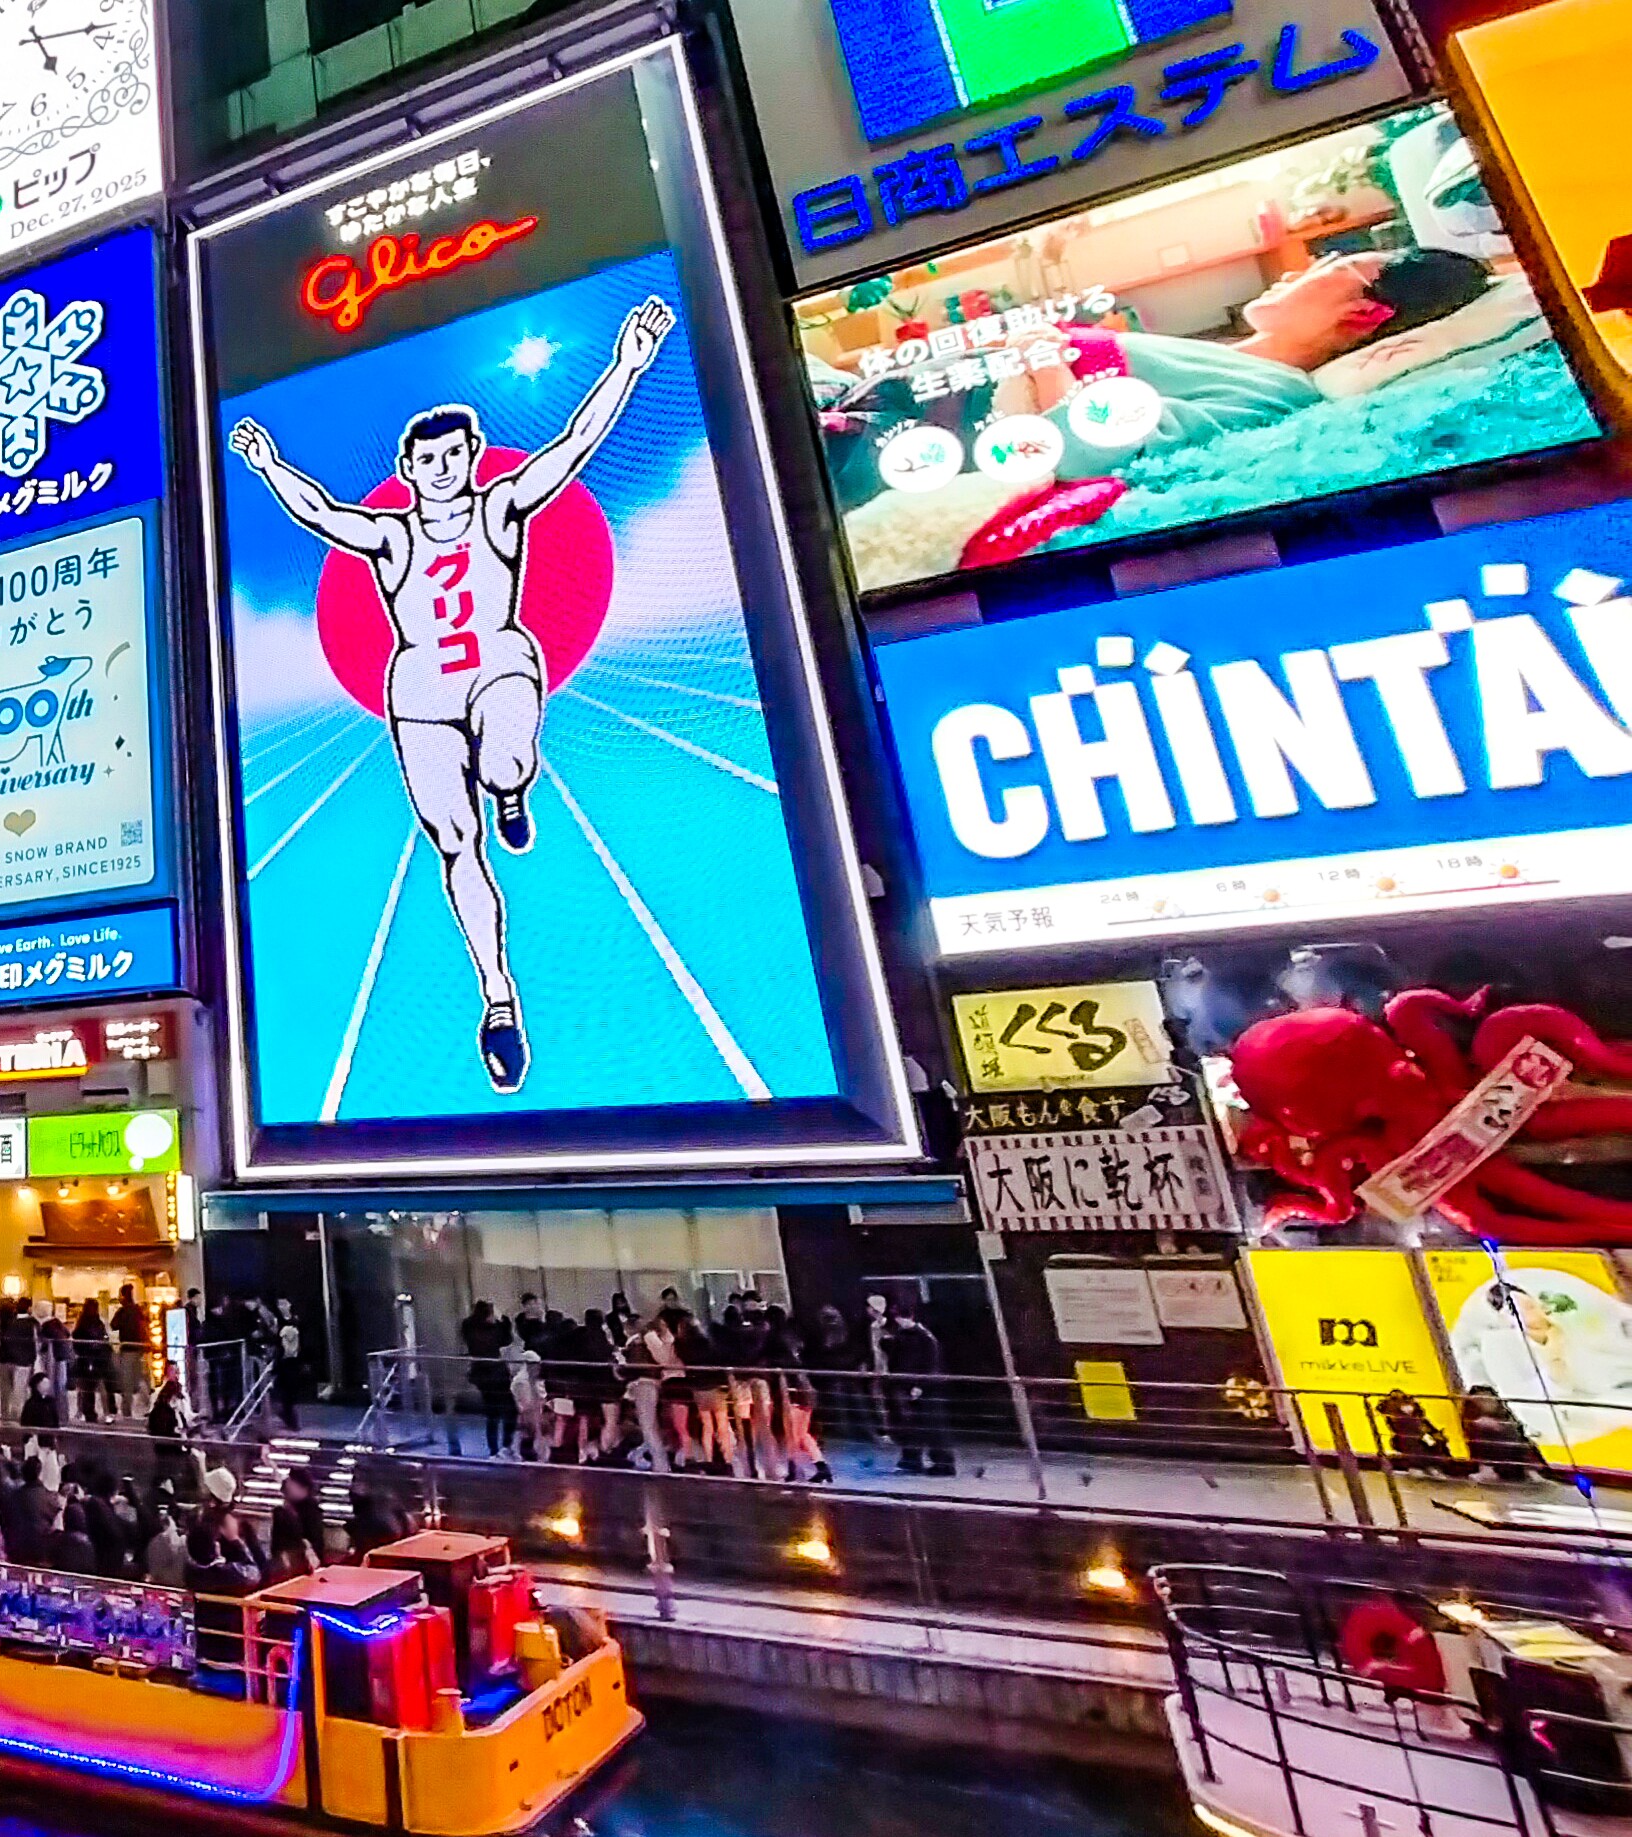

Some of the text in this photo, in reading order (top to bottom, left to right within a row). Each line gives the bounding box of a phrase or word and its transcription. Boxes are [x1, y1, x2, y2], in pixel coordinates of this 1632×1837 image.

[793, 23, 1380, 253] 日商エステム
[10, 168, 147, 240] Dec. 27, 2025
[14, 143, 101, 210] ピップ
[302, 215, 538, 333] Glico
[858, 284, 1115, 378] 体の回復助ける
[911, 341, 1081, 402] 生薬配合。
[5, 845, 48, 863] SNOW
[55, 836, 108, 856] BRAND
[16, 936, 55, 953] Earth.
[60, 932, 90, 947] Love
[93, 926, 122, 943] Life.
[959, 907, 1055, 936] 天気予報
[999, 1000, 1127, 1071] くくる
[987, 1147, 1184, 1212] 大阪に乾杯
